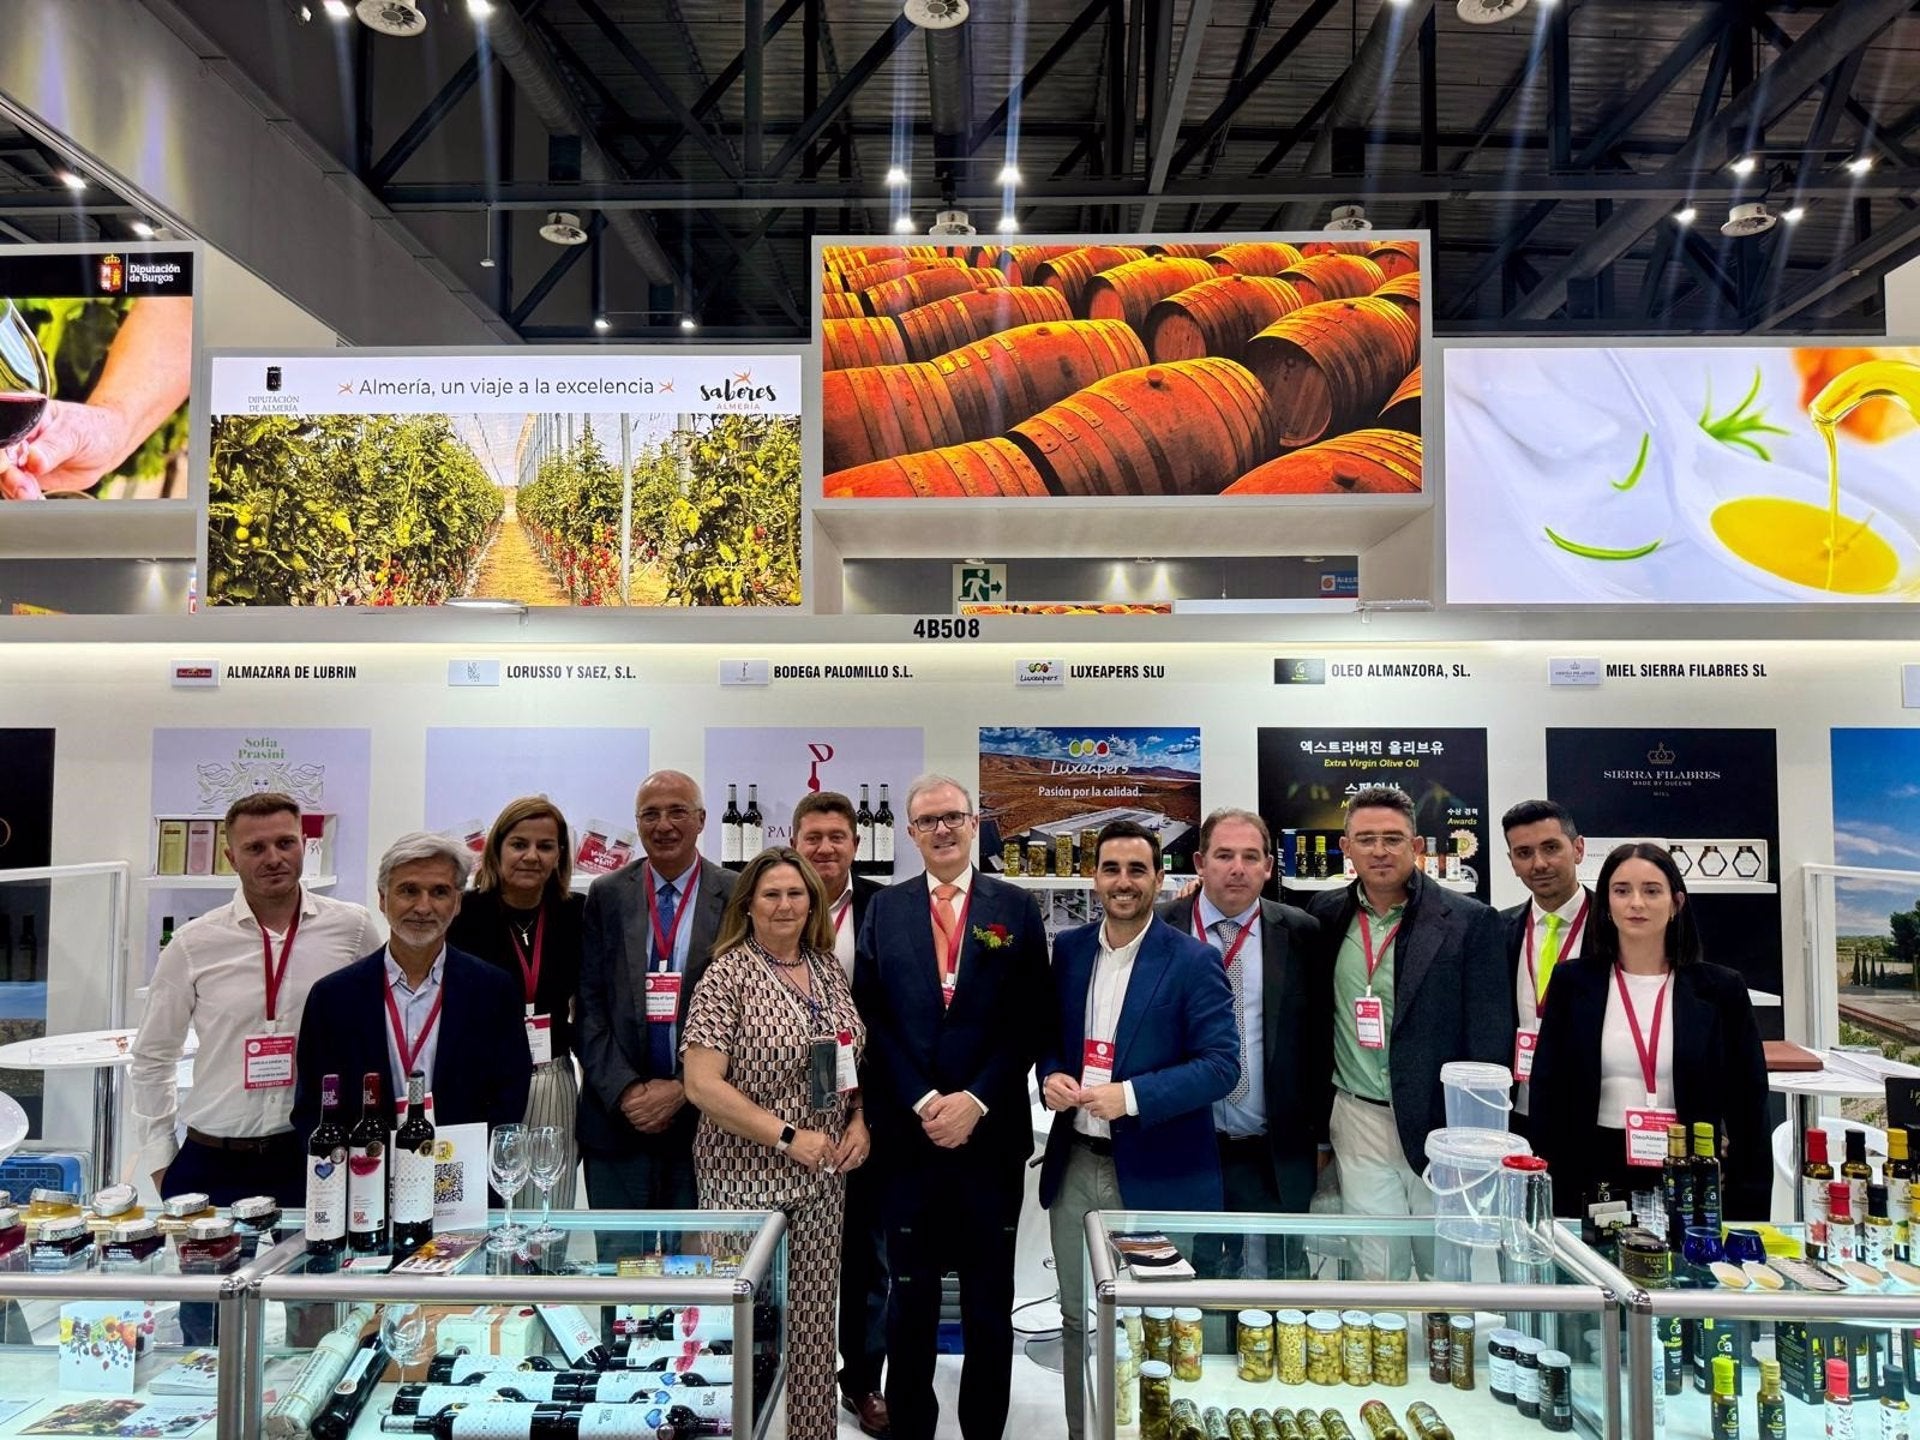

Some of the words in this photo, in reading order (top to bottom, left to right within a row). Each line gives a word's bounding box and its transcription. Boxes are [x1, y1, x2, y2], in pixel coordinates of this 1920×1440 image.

[129, 263, 181, 275] Diputación
[129, 273, 140, 282] de
[142, 273, 174, 284] Burgos
[359, 378, 436, 397] Almería,
[441, 383, 465, 395] un
[470, 378, 514, 398] viaje
[518, 383, 529, 395] a
[535, 378, 549, 394] la
[556, 377, 654, 394] excelencia
[700, 378, 777, 401] sabores
[247, 394, 300, 404] DIPUTACIÓN
[913, 618, 981, 639] 4B508
[227, 665, 290, 679] ALMAZARA
[294, 665, 310, 679] DE
[314, 665, 356, 679] LUBRIN
[507, 665, 562, 679] LORUSSO
[566, 665, 573, 679] Y
[577, 665, 610, 681] SAEZ,
[615, 665, 636, 679] S.L.
[773, 665, 820, 678] BODEGA
[824, 665, 888, 678] PALOMILLO
[892, 665, 913, 678] S.L.
[1070, 665, 1139, 679] LUXEAPERS
[1143, 665, 1165, 679] SLU
[1331, 664, 1363, 677] OLEO
[1367, 664, 1448, 679] ALMANZORA,
[1452, 664, 1471, 677] SL.
[1606, 664, 1636, 677] MIEL
[1640, 664, 1685, 677] SIERRA
[1689, 664, 1748, 677] FILABRES
[1752, 664, 1767, 677] SL
[238, 748, 285, 760] Prasini
[1299, 740, 1383, 755] 엑스트라버진
[1388, 740, 1445, 755] 올리브유
[1050, 761, 1129, 779] Luxeapers
[1324, 759, 1347, 768] Extra
[1349, 759, 1377, 770] Virgin
[1379, 759, 1403, 768] Olive
[1405, 759, 1420, 768] Oil
[1603, 770, 1653, 779] SIERRA
[1656, 770, 1721, 779] FILABRES
[1038, 786, 1071, 797] Pasión
[1073, 788, 1089, 799] por
[1091, 786, 1101, 796] la
[1103, 786, 1142, 797] calidad.
